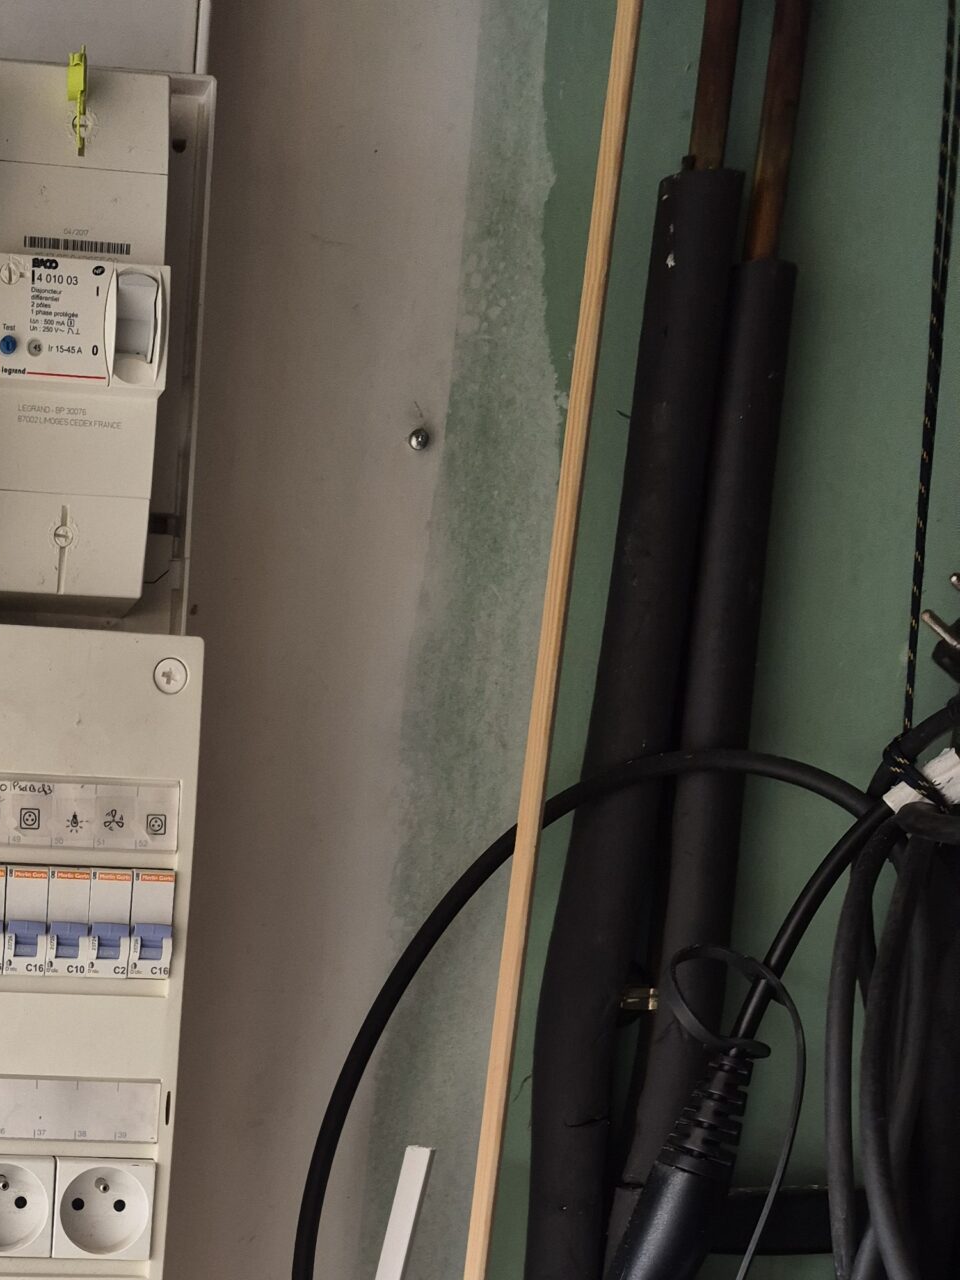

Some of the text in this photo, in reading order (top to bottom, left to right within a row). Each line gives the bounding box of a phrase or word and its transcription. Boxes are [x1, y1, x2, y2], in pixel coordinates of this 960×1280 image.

[37, 273, 79, 286] 4 010 03
[54, 311, 78, 319] protégée
[56, 345, 76, 354] 15-45
[1, 366, 26, 375] legrand
[18, 404, 50, 414] LEGRAND
[40, 416, 69, 426] LIMOGES
[70, 419, 93, 428] CEDEX
[94, 421, 122, 430] FRANCE
[26, 964, 44, 973] C16
[67, 965, 85, 974] C10
[113, 966, 126, 975] C2
[151, 966, 169, 975] C16
